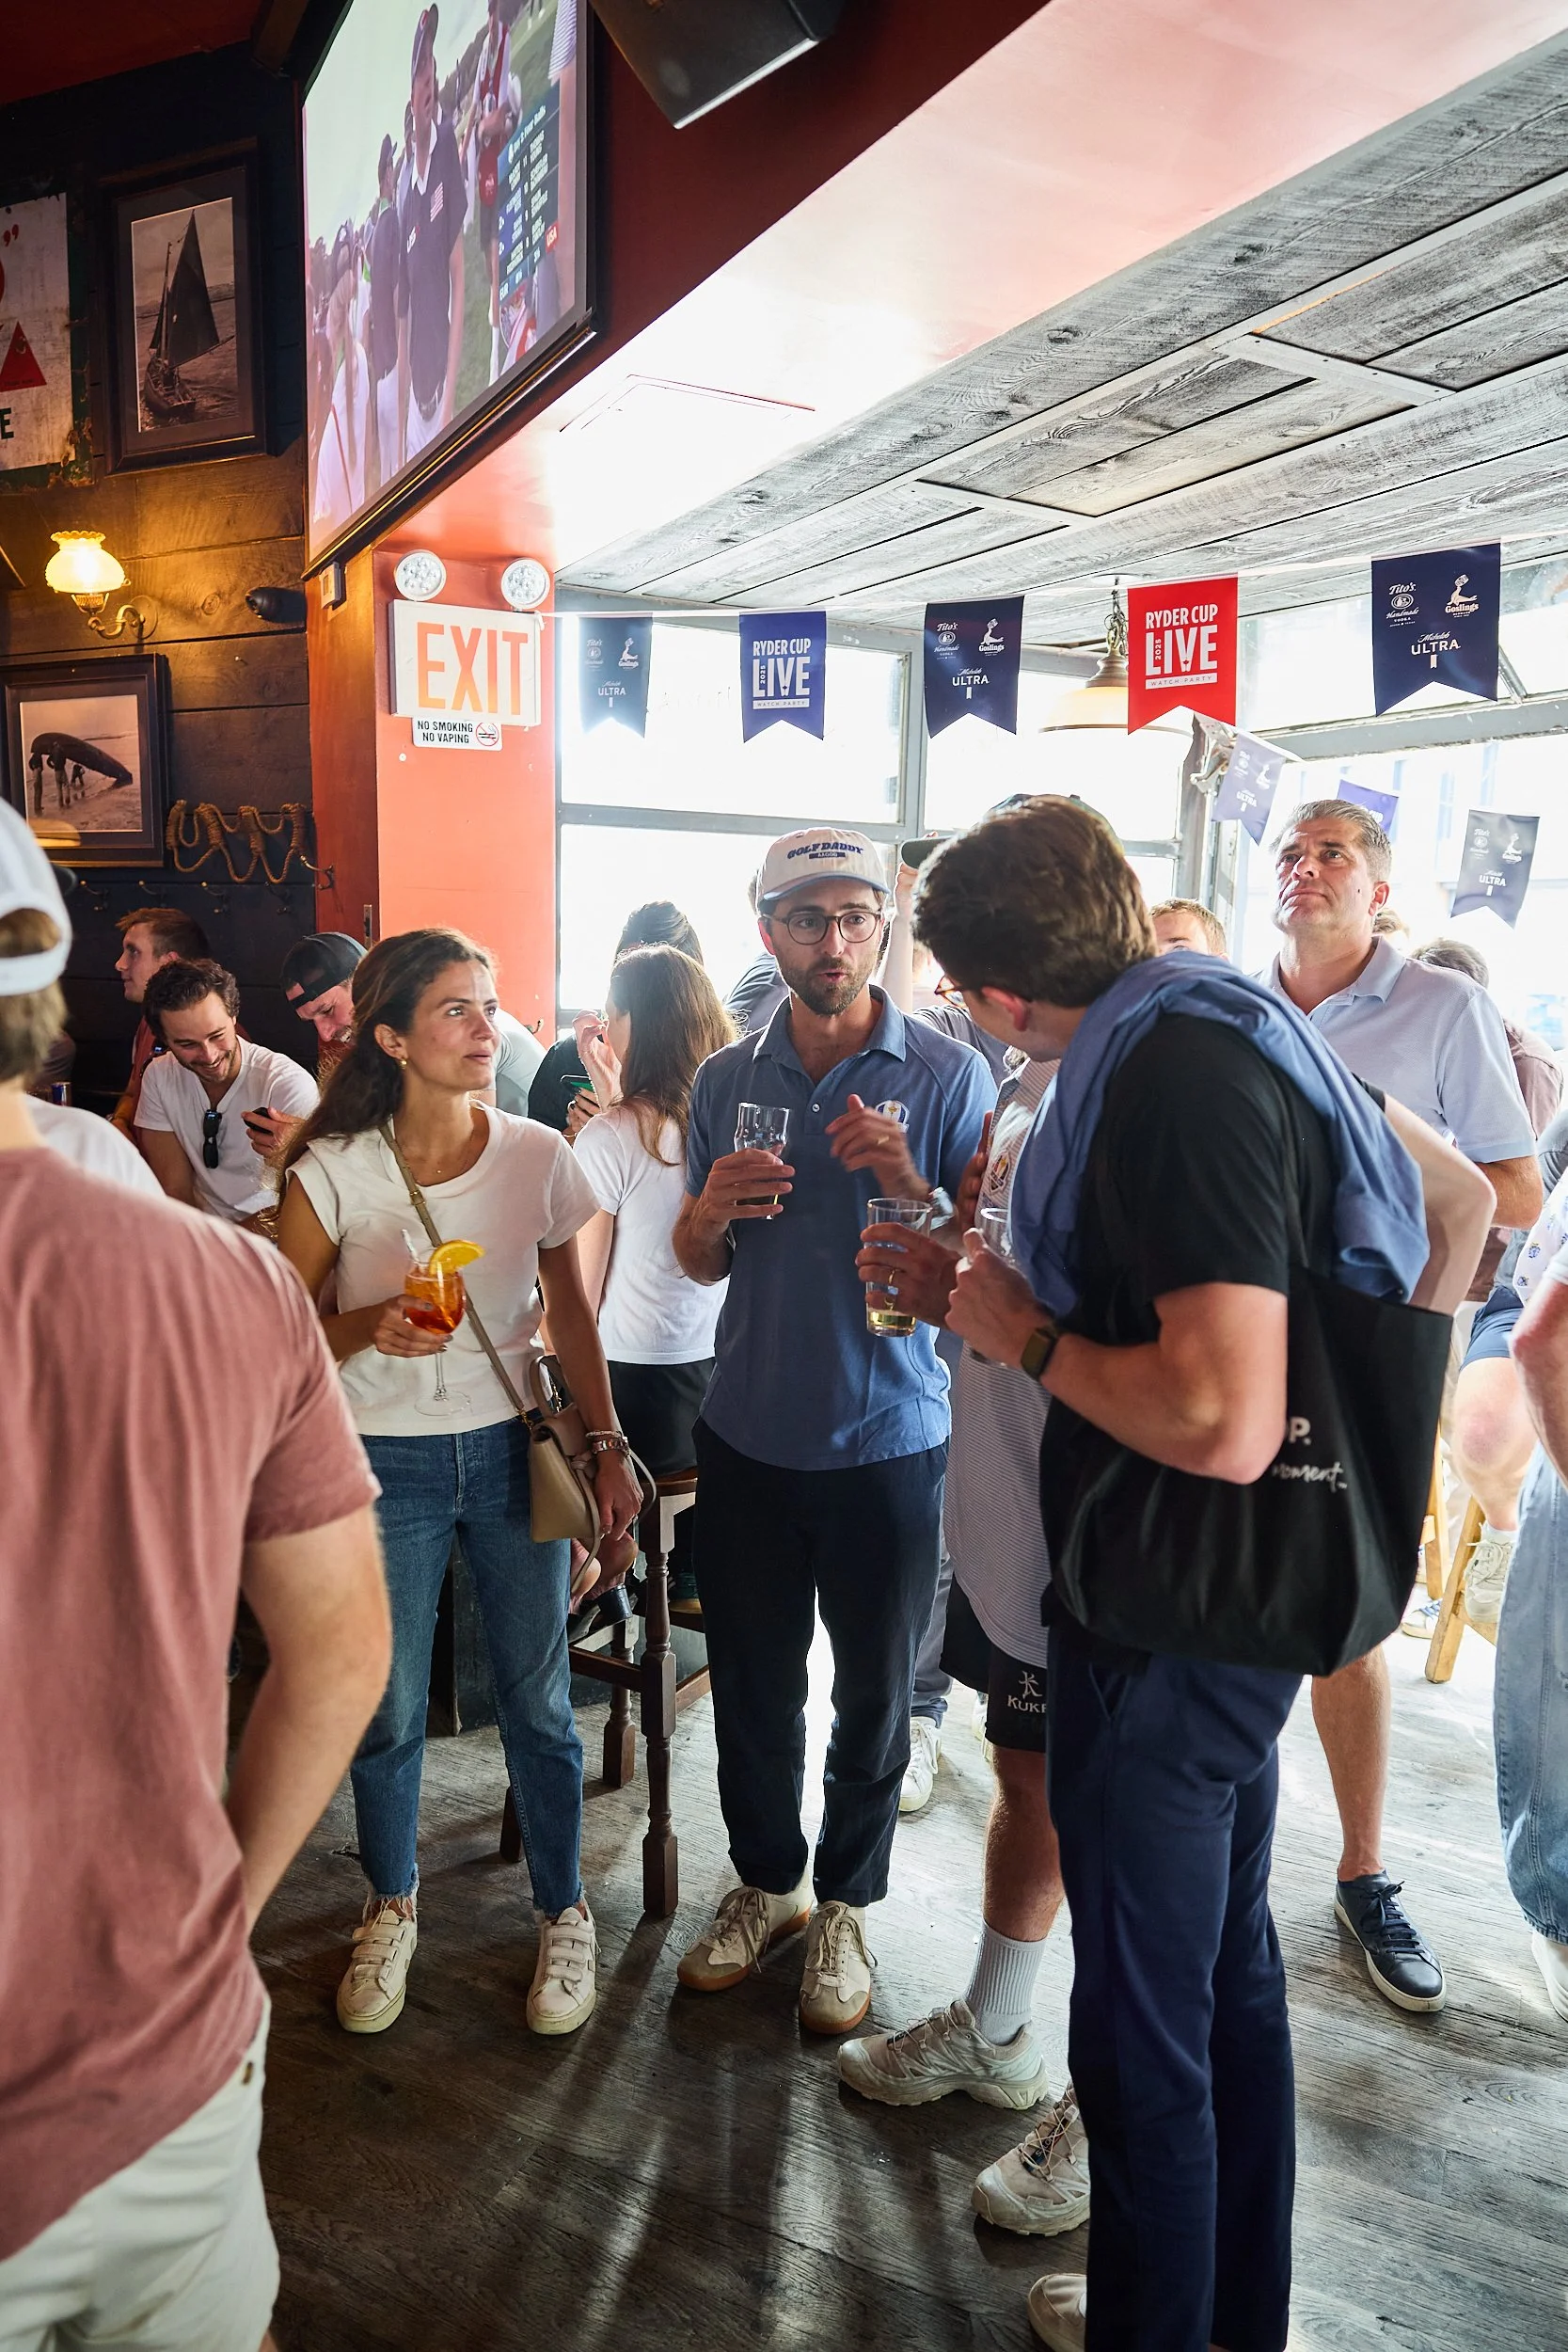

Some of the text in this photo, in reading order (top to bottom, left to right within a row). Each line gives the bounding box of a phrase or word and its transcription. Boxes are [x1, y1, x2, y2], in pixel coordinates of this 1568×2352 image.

[546, 226, 558, 247] USA
[1146, 604, 1218, 629] RYDER CUP
[1445, 603, 1479, 613] Goslings
[753, 638, 811, 657] RYDER CUP
[1146, 624, 1217, 676] LIVE
[1411, 639, 1461, 656] ULTRA
[417, 622, 528, 715] EXIT
[753, 656, 810, 697] LIVE
[952, 675, 989, 687] ULTRA
[597, 687, 626, 696] ULTRA
[418, 720, 473, 733] NO SMOKING
[422, 732, 469, 743] NO VAPING
[787, 842, 863, 859] GOLF DADDY
[1479, 874, 1506, 886] ULTRA
[1285, 1417, 1311, 1445] P.
